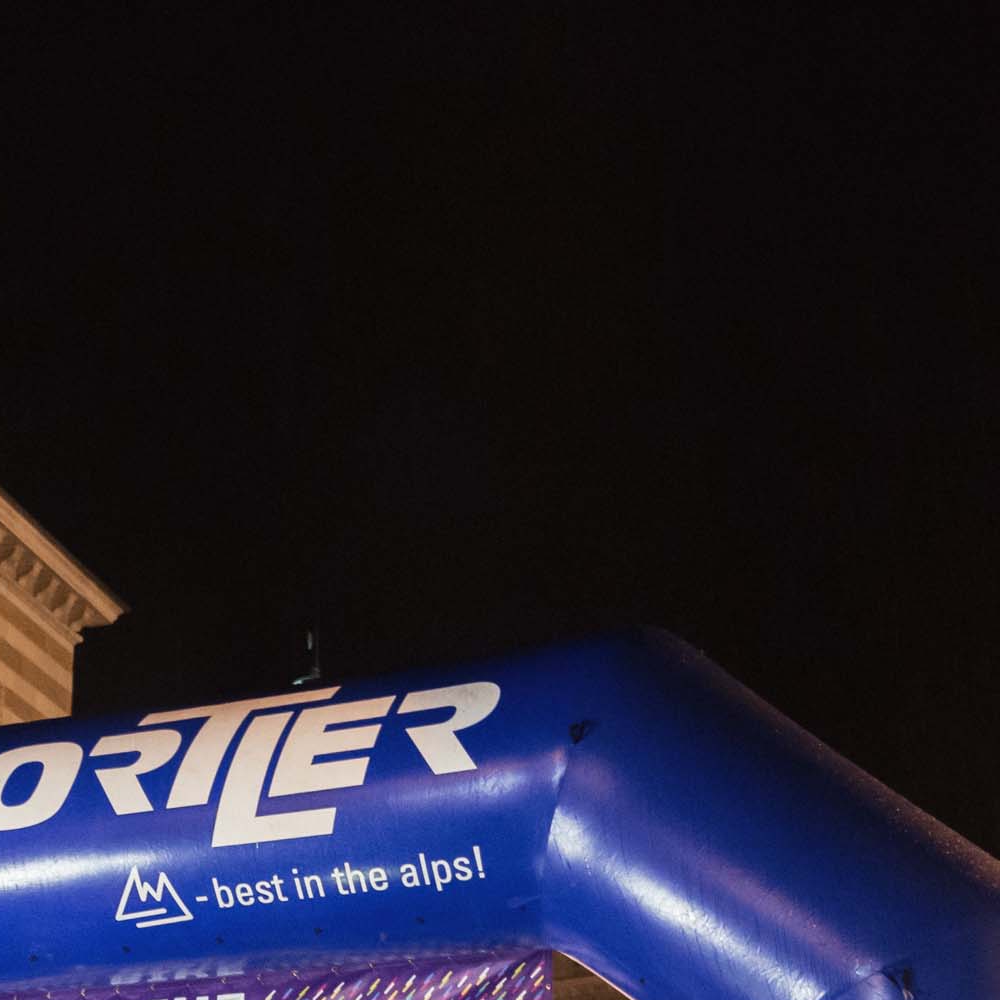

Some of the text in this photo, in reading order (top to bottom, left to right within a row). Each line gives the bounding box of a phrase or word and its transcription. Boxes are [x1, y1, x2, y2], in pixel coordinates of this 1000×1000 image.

[292, 868, 326, 900] in
[331, 862, 389, 896] the
[400, 846, 486, 892] alps!
